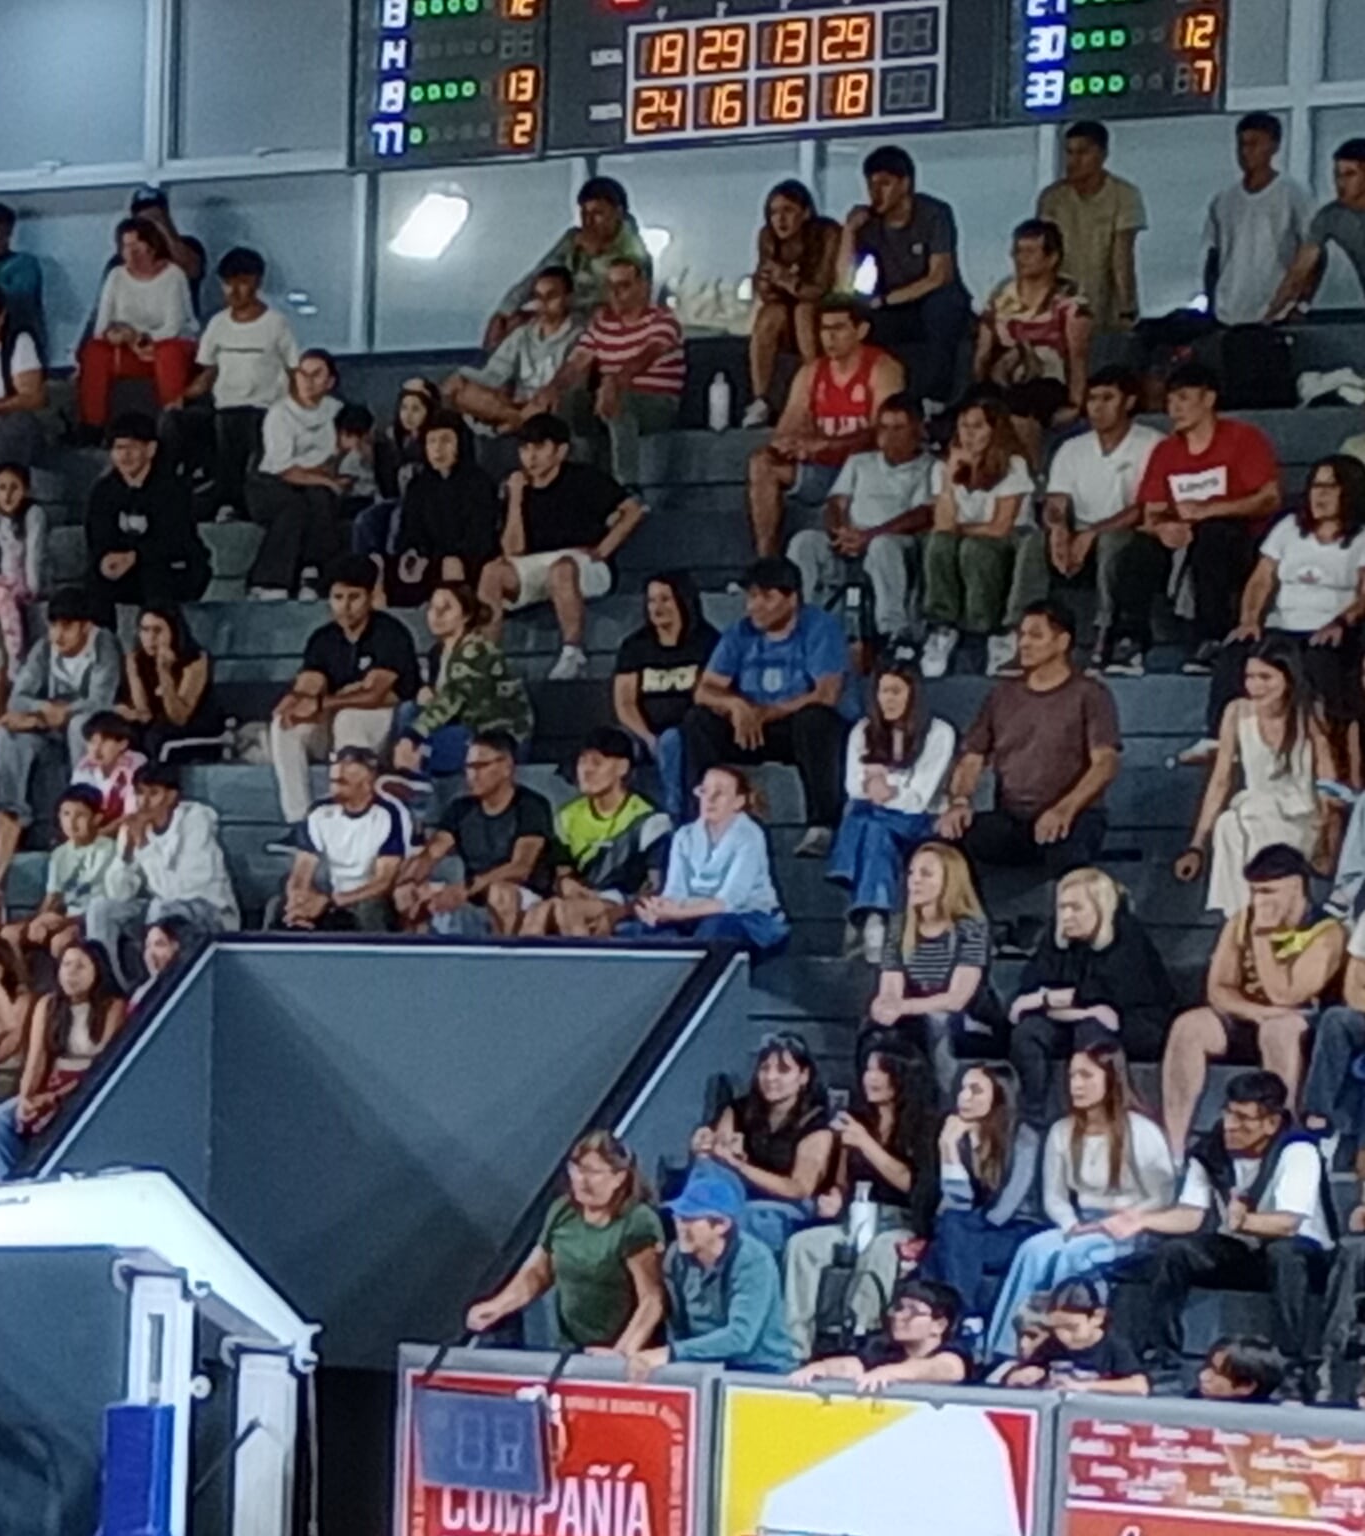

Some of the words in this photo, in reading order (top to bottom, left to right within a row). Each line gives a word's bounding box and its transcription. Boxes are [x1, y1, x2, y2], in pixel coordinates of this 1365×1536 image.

[650, 33, 684, 75] 19
[698, 28, 745, 71] 29
[773, 22, 807, 65] 13
[822, 16, 870, 62] 29
[1183, 14, 1216, 48] 12
[508, 69, 536, 102] 13
[1193, 60, 1214, 92] 7
[635, 90, 682, 131] 24
[711, 84, 743, 125] 16
[773, 78, 805, 120] 16
[835, 72, 869, 115] 18
[513, 112, 533, 144] 2
